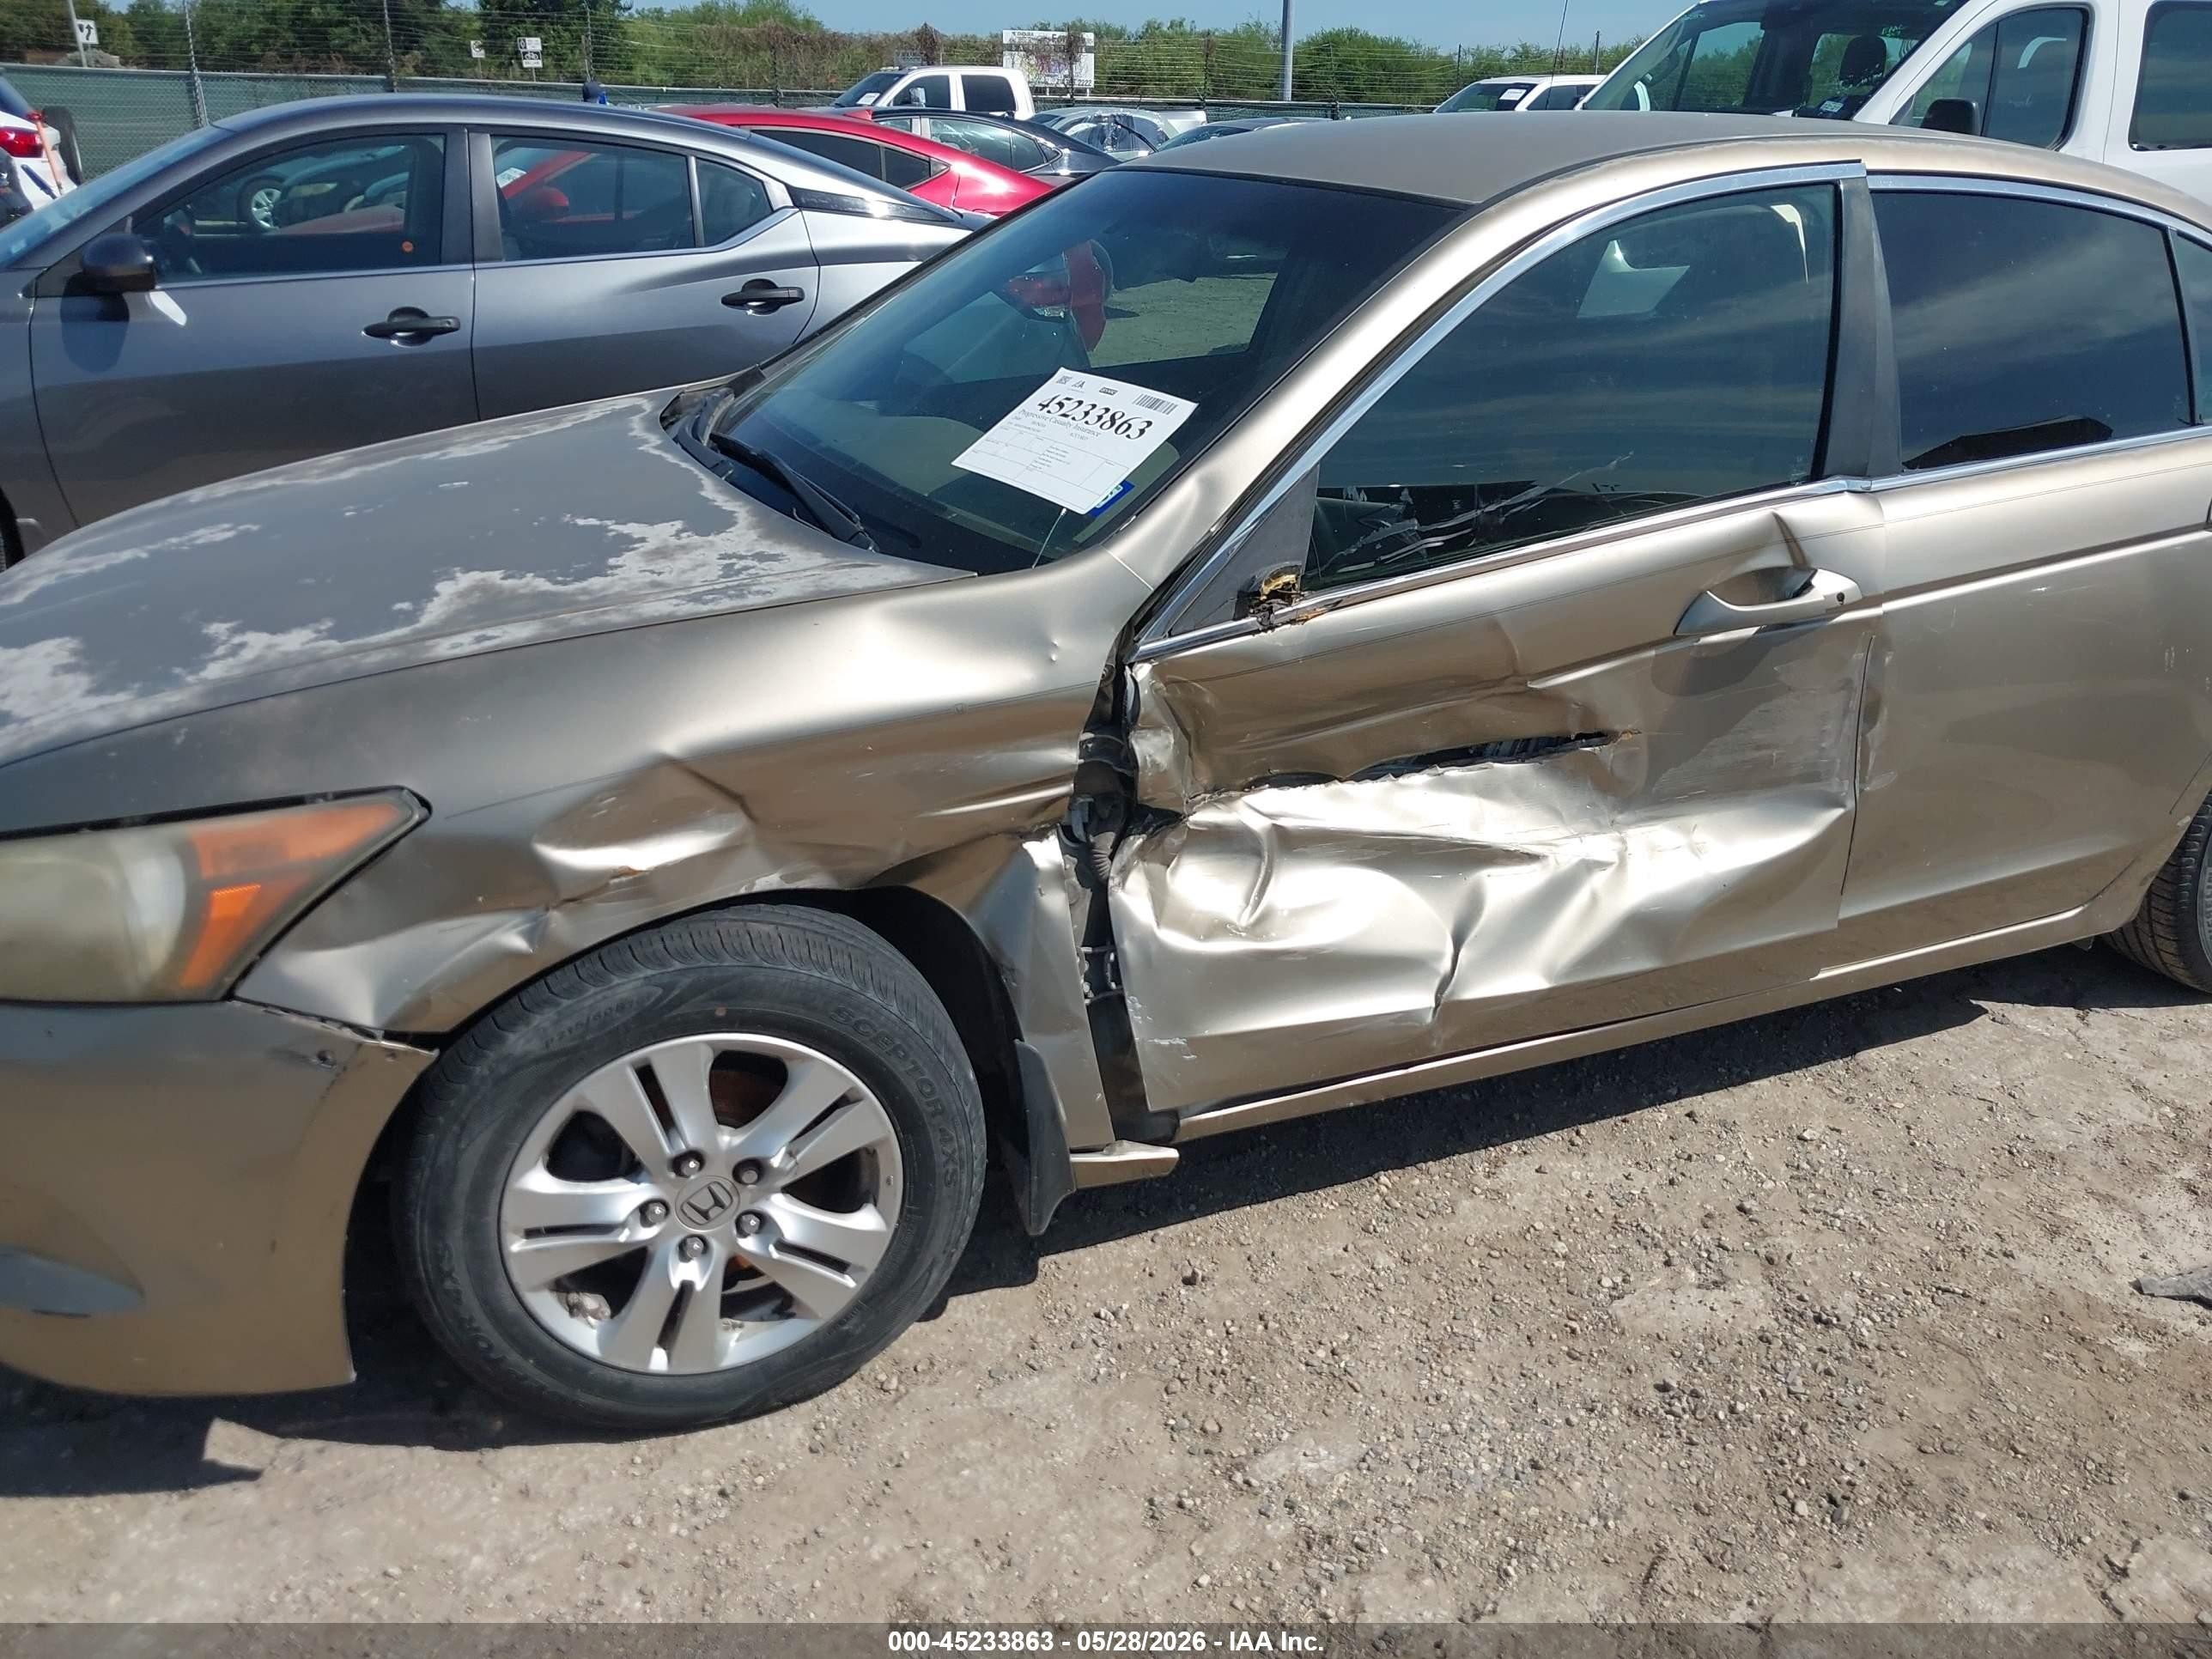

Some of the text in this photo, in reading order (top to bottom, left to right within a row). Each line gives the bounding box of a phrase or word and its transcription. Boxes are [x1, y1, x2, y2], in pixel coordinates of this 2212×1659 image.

[1037, 394, 1153, 441] 45233863
[829, 1006, 959, 1189] SCEPTOR 4XS
